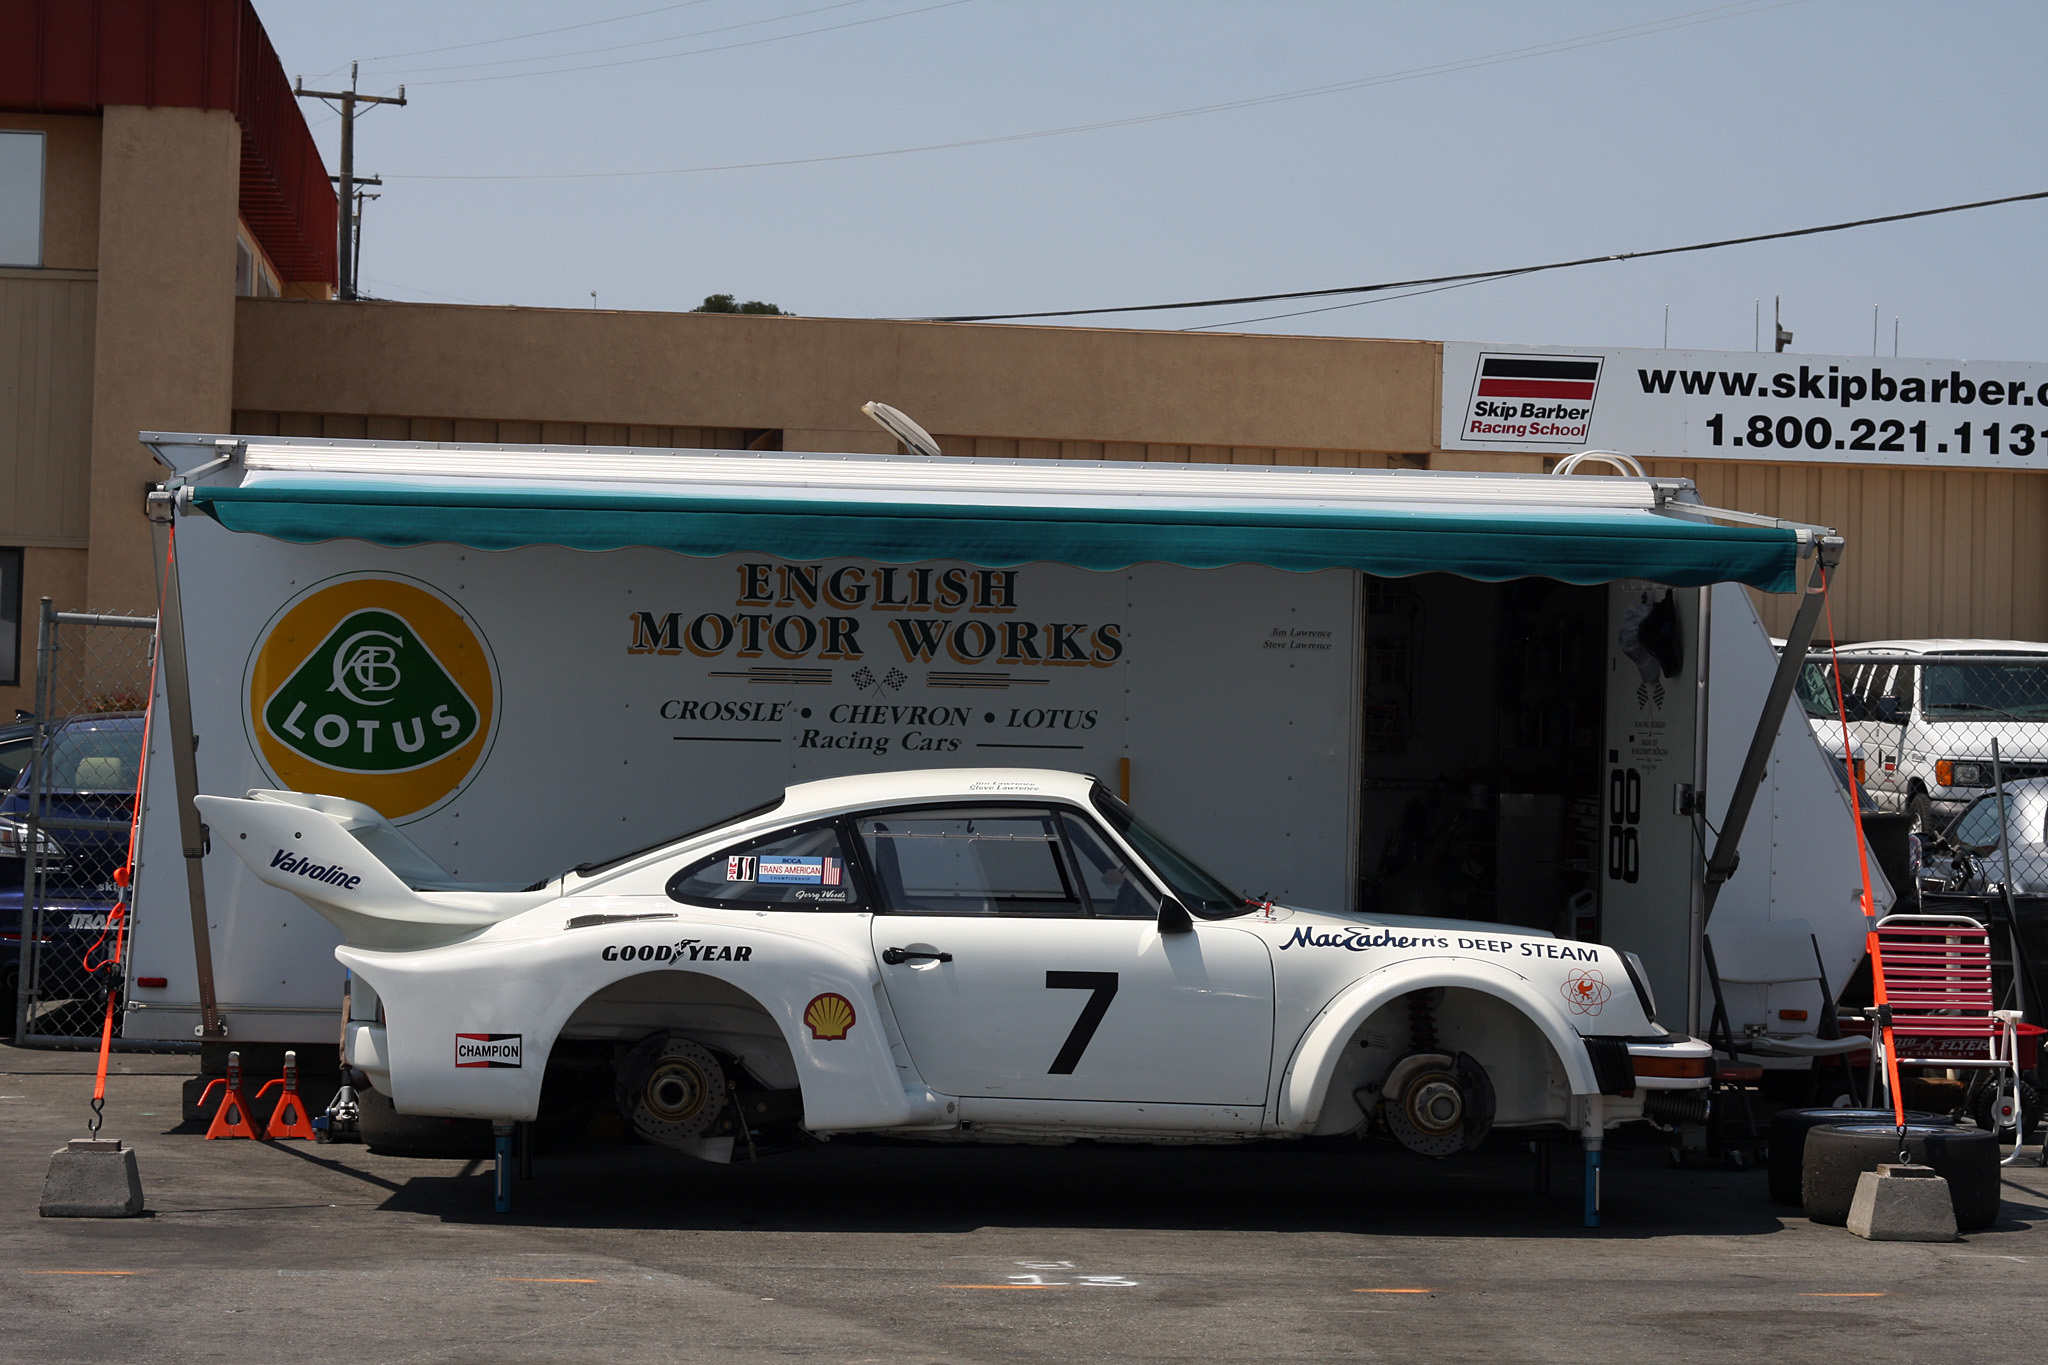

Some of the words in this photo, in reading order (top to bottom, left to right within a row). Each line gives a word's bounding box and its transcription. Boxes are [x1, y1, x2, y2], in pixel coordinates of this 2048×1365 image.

[1474, 401, 1518, 421] Skip
[1520, 402, 1590, 420] Barber
[1470, 420, 1527, 437] Racing
[1529, 422, 1587, 436] School
[735, 563, 1019, 614] ENGLISH
[628, 611, 864, 661] MOTOR
[887, 617, 1124, 668] WORKS
[1263, 639, 1287, 649] Steve
[1289, 640, 1332, 649] Lawrence
[1270, 627, 1287, 637] Jim
[1290, 628, 1332, 637] Lawrence
[282, 700, 461, 754] LOTUS
[828, 703, 973, 727] CHEVRON
[1006, 708, 1099, 730] LOTUS
[798, 728, 891, 756] Racing
[901, 730, 962, 752] Cars
[270, 849, 361, 890] Valvoline
[728, 856, 738, 880] IMSA
[760, 865, 783, 874] TRANS
[784, 866, 821, 875] AMERICAN
[1458, 938, 1513, 953] DEEP
[1520, 943, 1599, 963] STEAM
[1045, 970, 1119, 1075] 7
[459, 1045, 519, 1058] CHAMPION
[1939, 1040, 1990, 1050] FLYER
